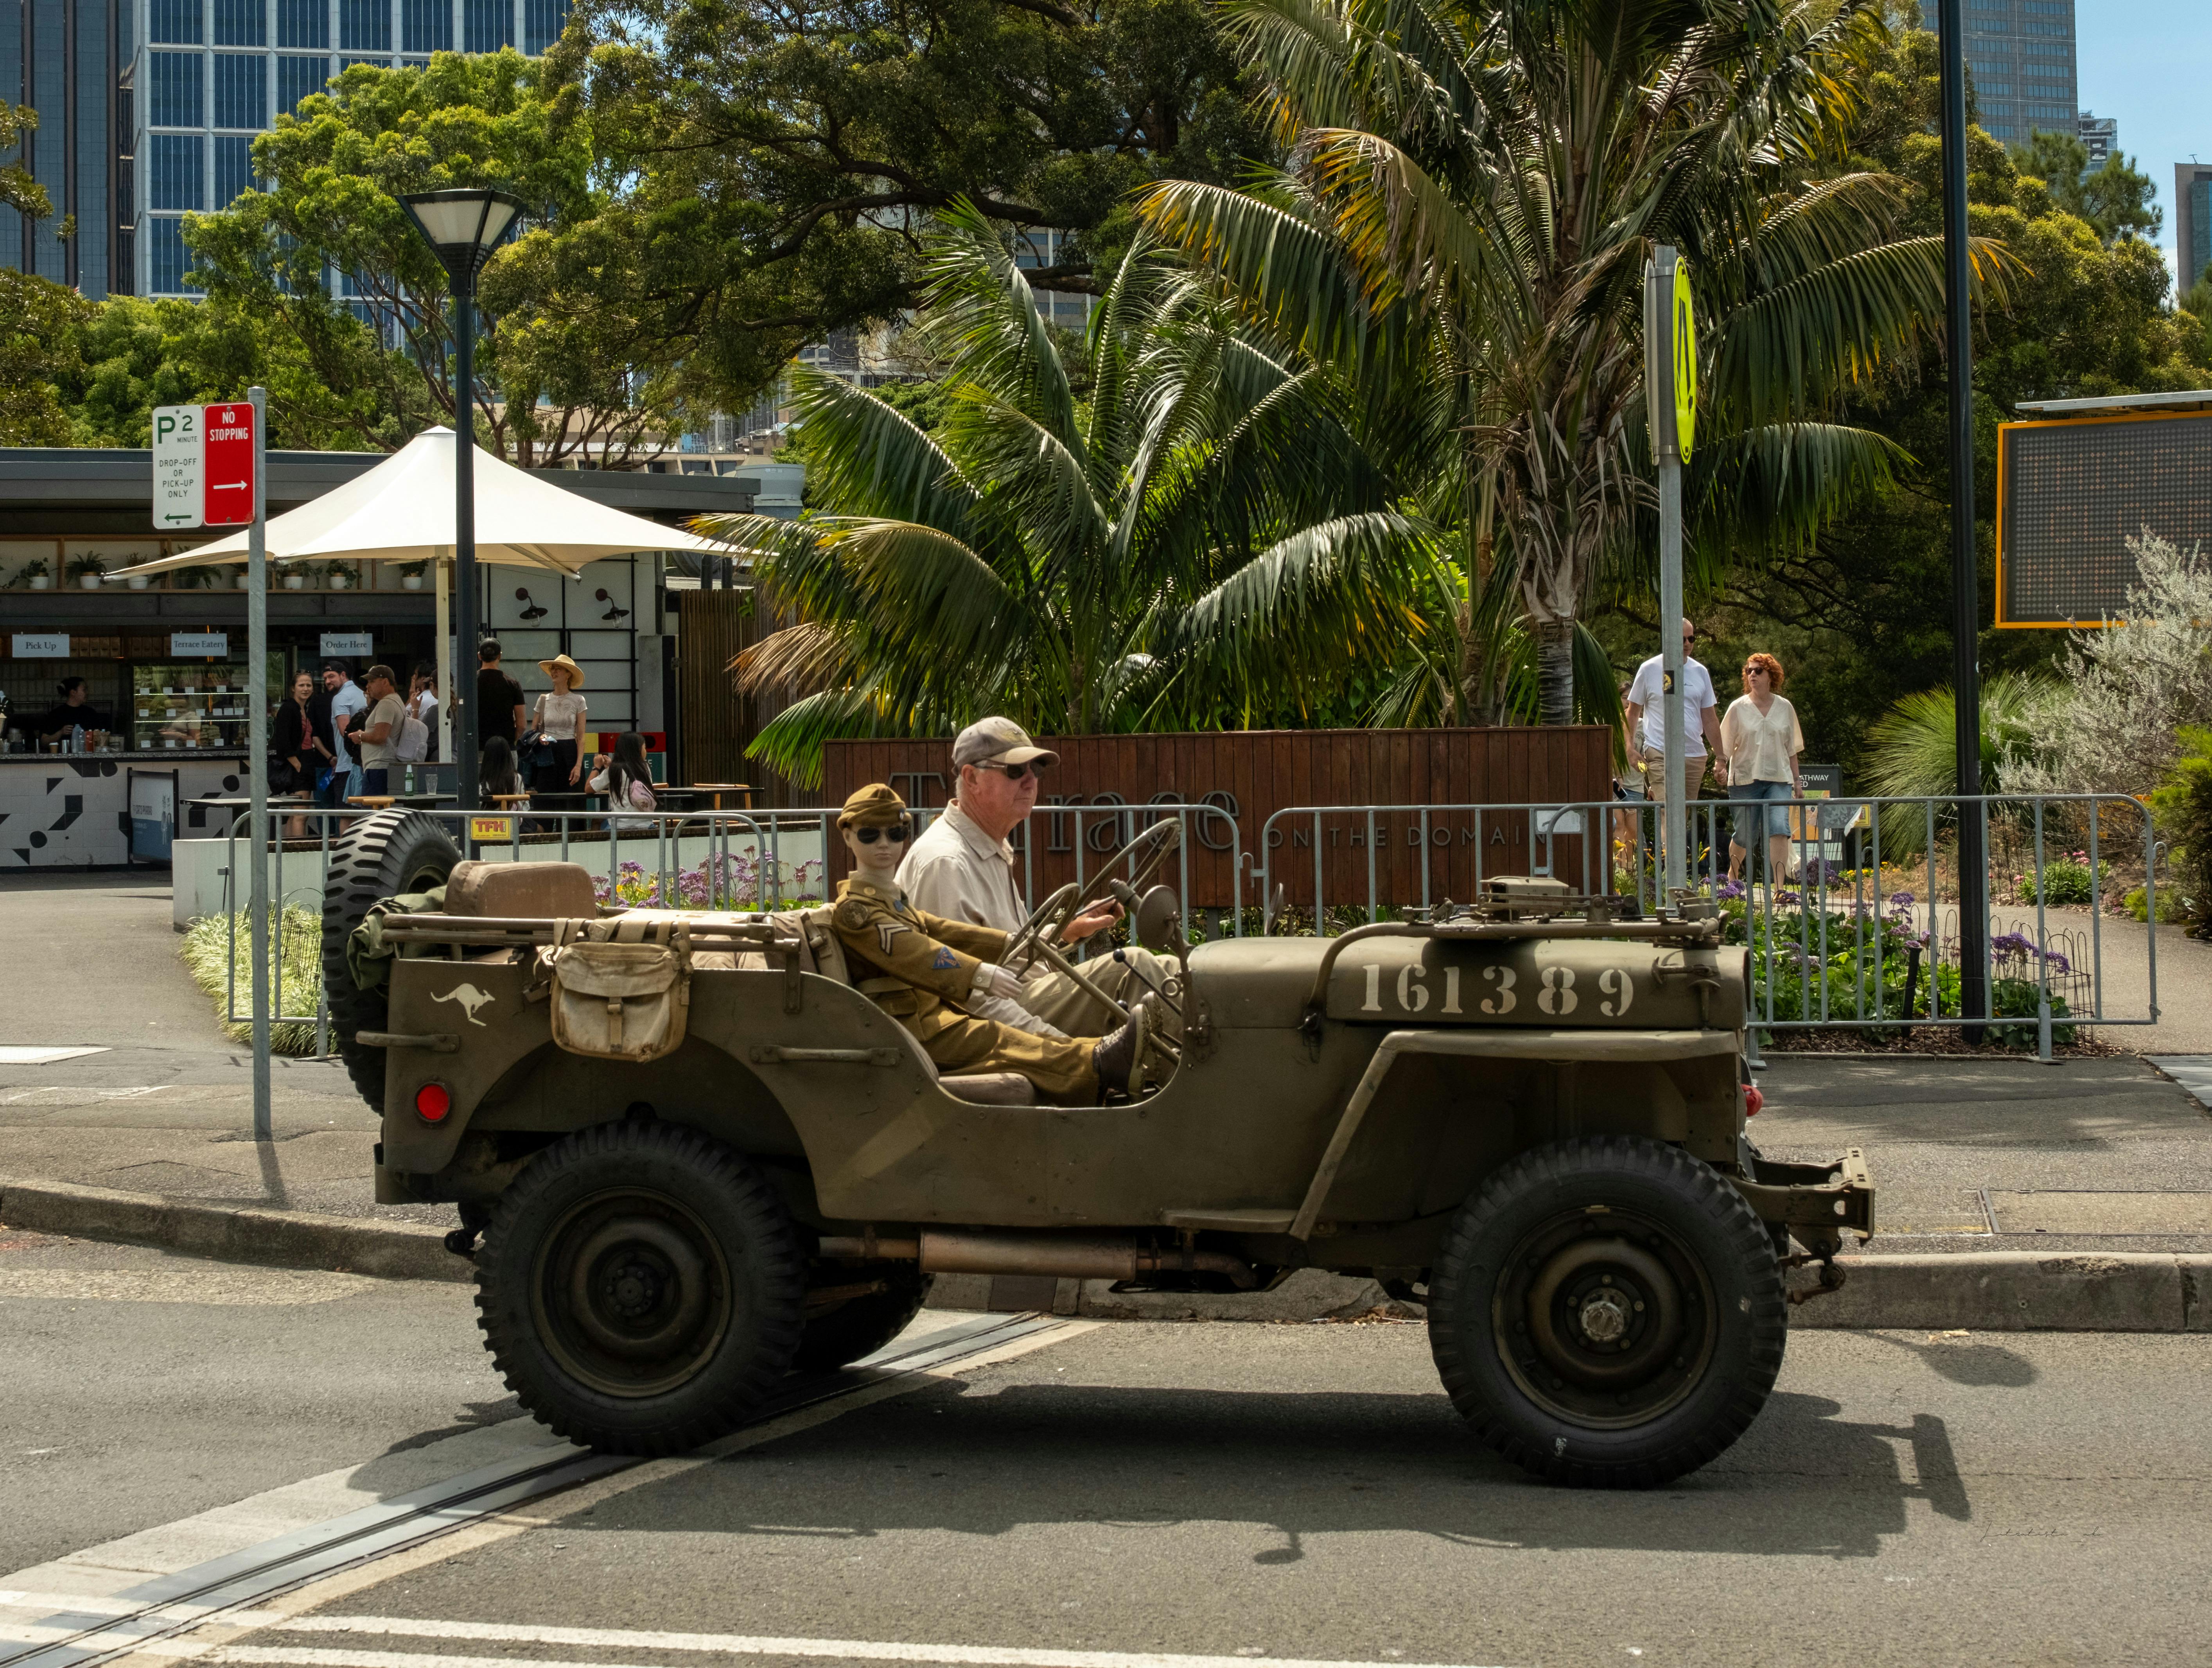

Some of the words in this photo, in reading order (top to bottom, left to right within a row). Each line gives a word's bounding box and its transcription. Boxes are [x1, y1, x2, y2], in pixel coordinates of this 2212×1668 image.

[222, 411, 235, 424] NO
[158, 416, 176, 444] P
[182, 415, 193, 432] 2
[210, 427, 248, 442] STOPPING
[159, 458, 197, 467] DROP-OFF
[2023, 451, 2140, 493] THIS
[163, 479, 194, 488] PICK-UP
[2026, 555, 2122, 595] NYE
[44, 642, 56, 651] Up
[202, 641, 225, 649] Eatery
[887, 772, 1239, 851] Trace
[475, 821, 503, 832] TFH
[1268, 828, 1309, 847] ON
[1330, 827, 1386, 846] THE
[1361, 964, 1634, 1017] 161389
